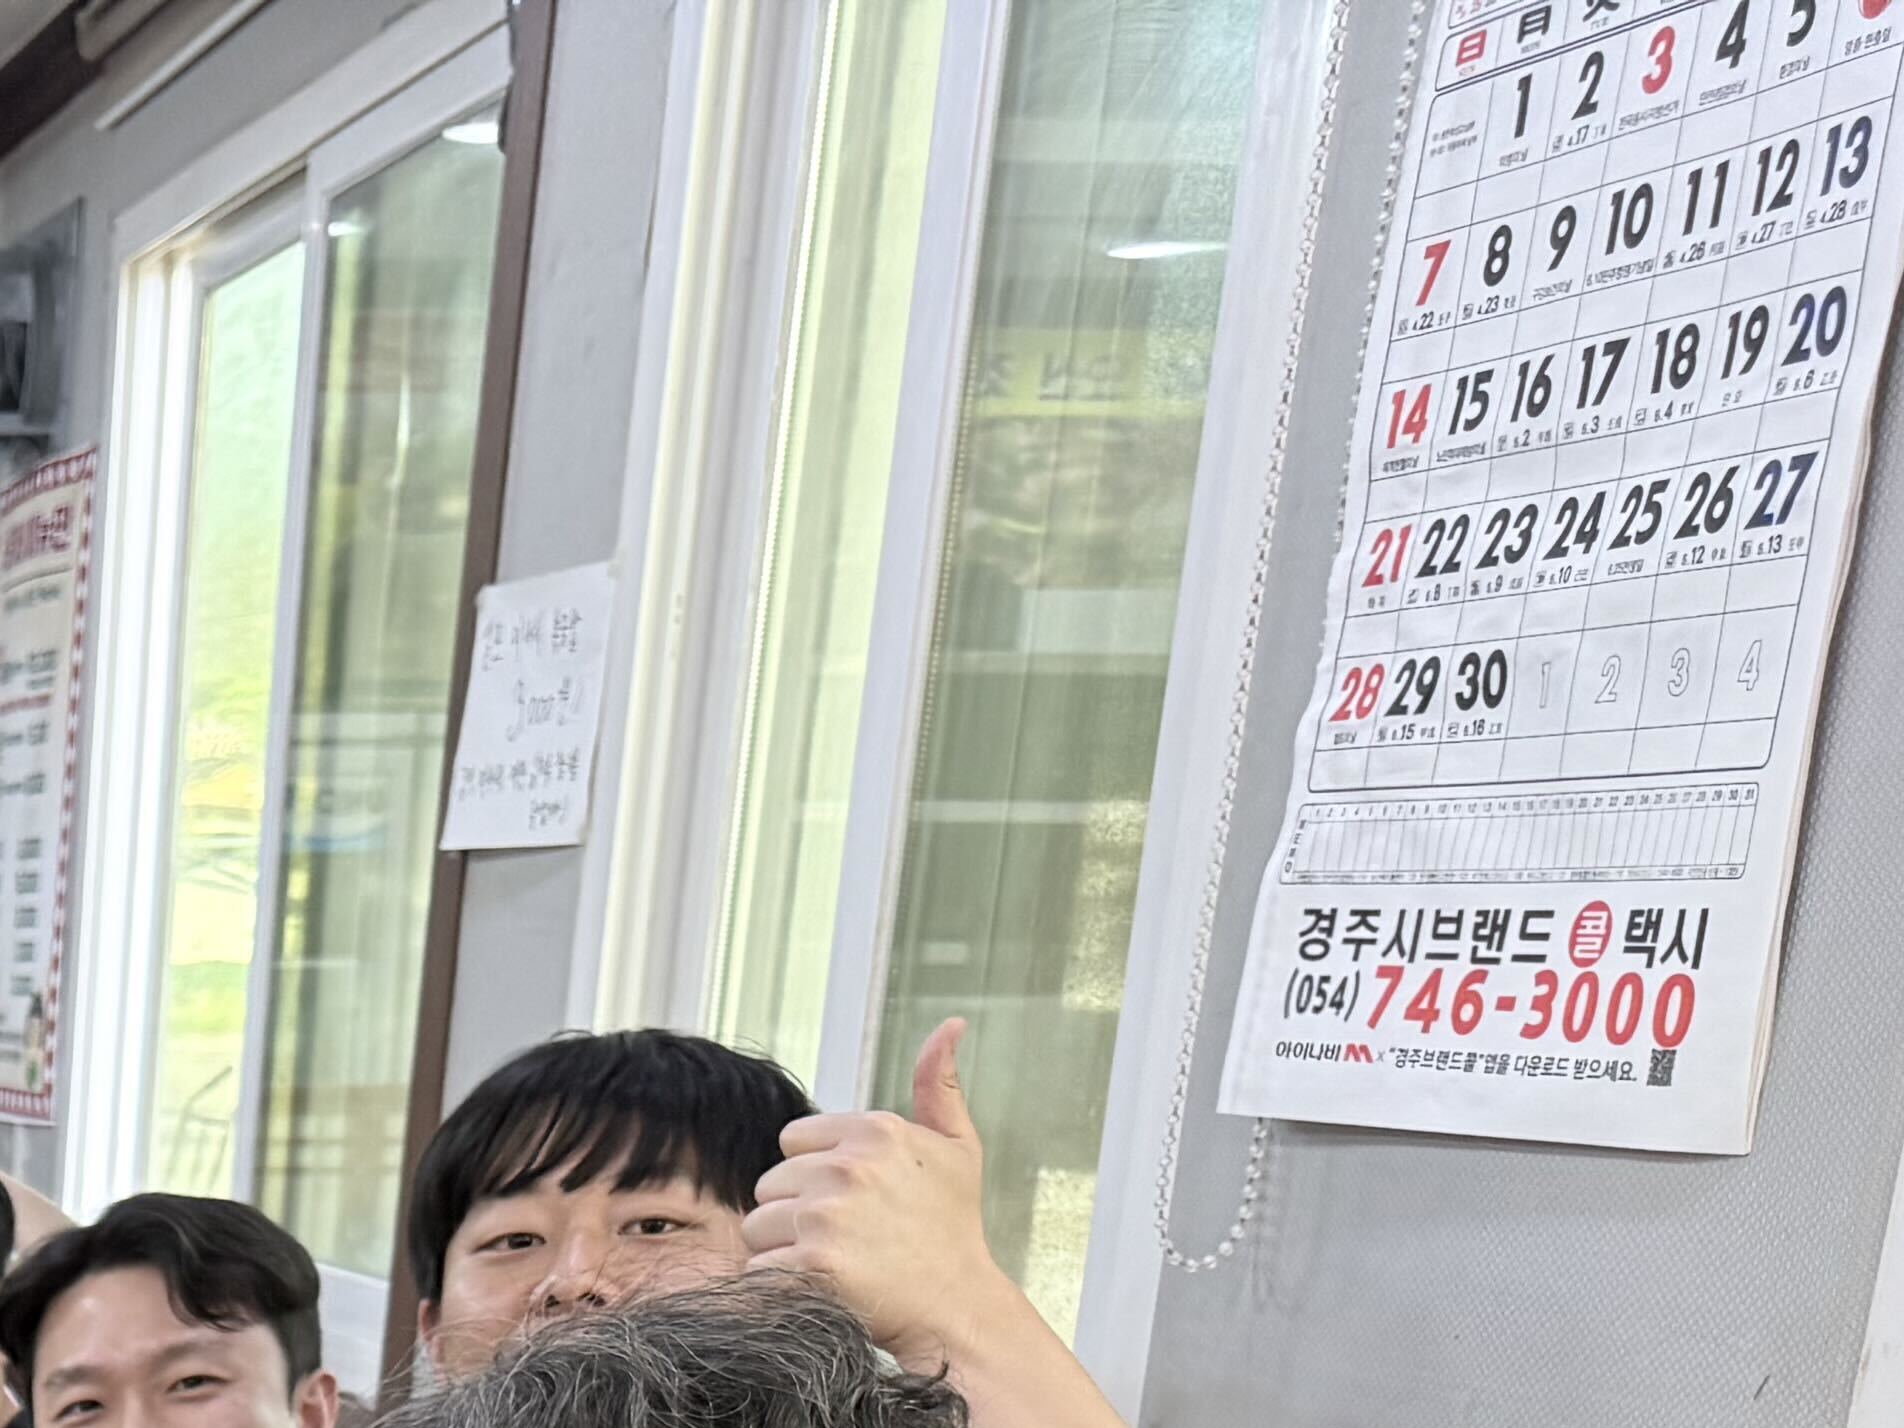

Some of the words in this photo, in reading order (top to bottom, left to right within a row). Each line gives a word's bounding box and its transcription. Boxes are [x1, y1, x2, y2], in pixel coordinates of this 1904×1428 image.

[1514, 73, 1532, 138] 1
[1571, 51, 1604, 120] 2
[1642, 26, 1675, 94] 3
[1715, 0, 1749, 69] 4
[1415, 239, 1452, 306] 7
[1483, 224, 1512, 287] 8
[1547, 205, 1576, 271] 9
[1605, 182, 1653, 256] 10
[1682, 159, 1730, 236] 11
[1751, 138, 1800, 216] 12
[1820, 115, 1873, 196] 13
[1387, 383, 1432, 449] 14
[1448, 368, 1494, 435] 15
[1510, 353, 1555, 423] 16
[1576, 337, 1631, 409] 17
[1651, 323, 1700, 394] 18
[1721, 305, 1770, 380] 19
[1780, 286, 1847, 367] 20
[1362, 523, 1412, 587] 21
[1415, 514, 1470, 578] 22
[1474, 504, 1538, 569] 23
[1542, 490, 1606, 560] 24
[1607, 478, 1671, 551] 25
[1673, 465, 1740, 540] 26
[1743, 451, 1819, 530] 27
[1328, 663, 1385, 722] 28
[1384, 656, 1441, 716] 29
[1455, 649, 1507, 711] 30
[1539, 661, 1551, 708] 1
[1594, 654, 1621, 704] 2
[1668, 647, 1690, 697] 3
[1737, 639, 1762, 691] 4
[1299, 908, 1555, 965] 경주시브랜드
[1573, 910, 1608, 959] 콜
[1623, 907, 1709, 969] 택시
[1276, 1041, 1341, 1062] 아이나비
[1514, 1055, 1570, 1077] 다운로드
[1573, 1058, 1637, 1082] 받으세요.
[1284, 967, 1360, 1022] (054)
[1367, 965, 1695, 1049] 746-3000
